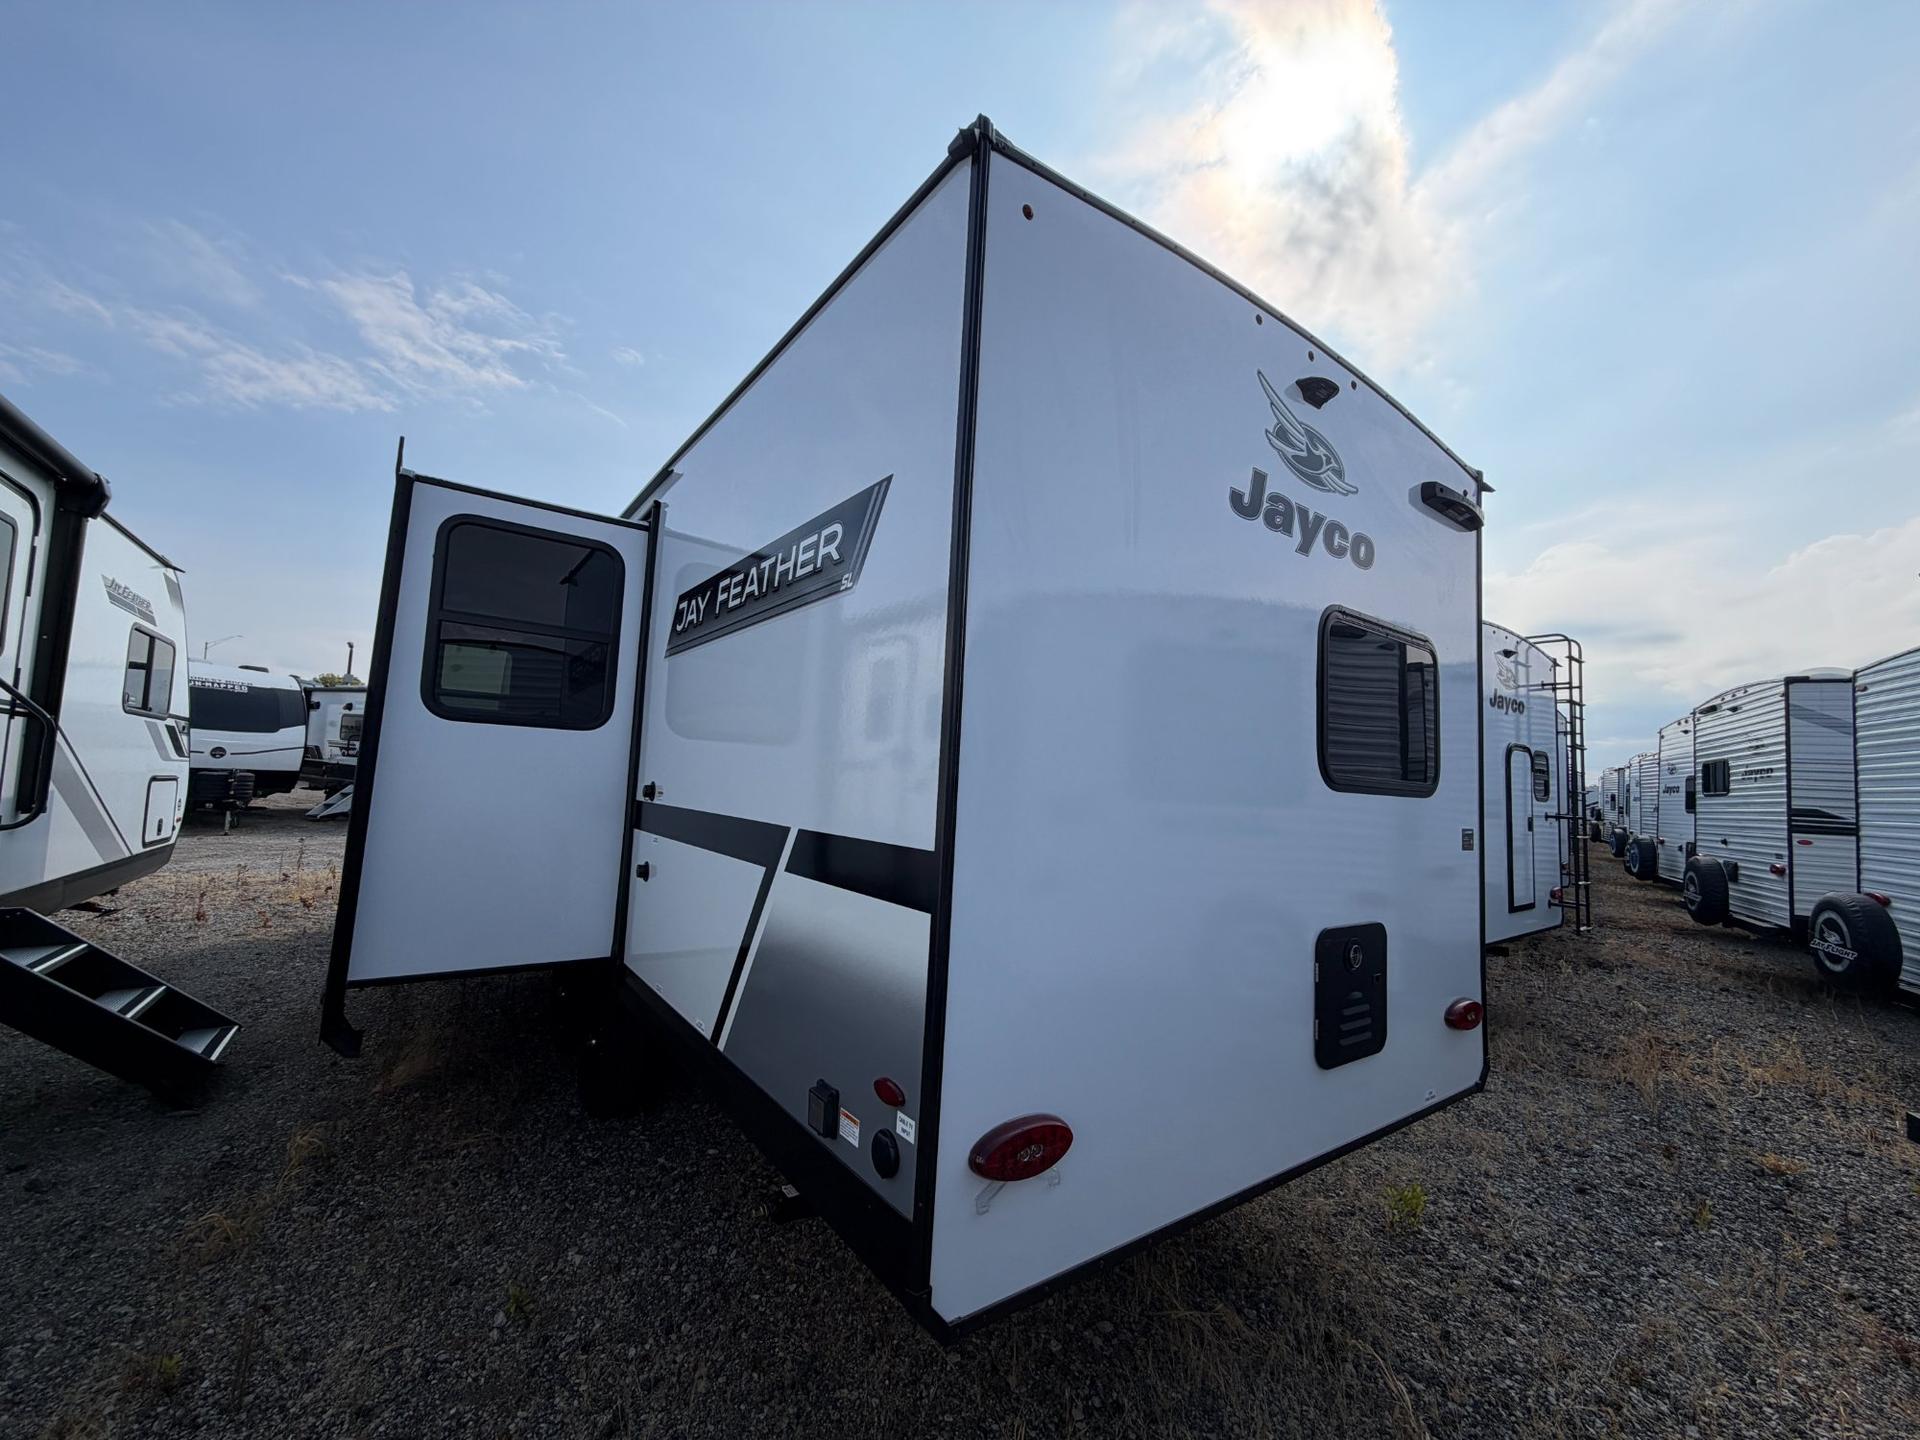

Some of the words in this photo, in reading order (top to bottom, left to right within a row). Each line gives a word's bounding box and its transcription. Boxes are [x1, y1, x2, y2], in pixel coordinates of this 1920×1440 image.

[1228, 466, 1376, 570] Jayco
[675, 590, 711, 633] JAY
[715, 522, 845, 616] FEATHER
[839, 572, 855, 592] SL
[1489, 688, 1525, 715] Jayco
[1662, 784, 1680, 796] Jayco
[1825, 944, 1857, 959] FLIGHT
